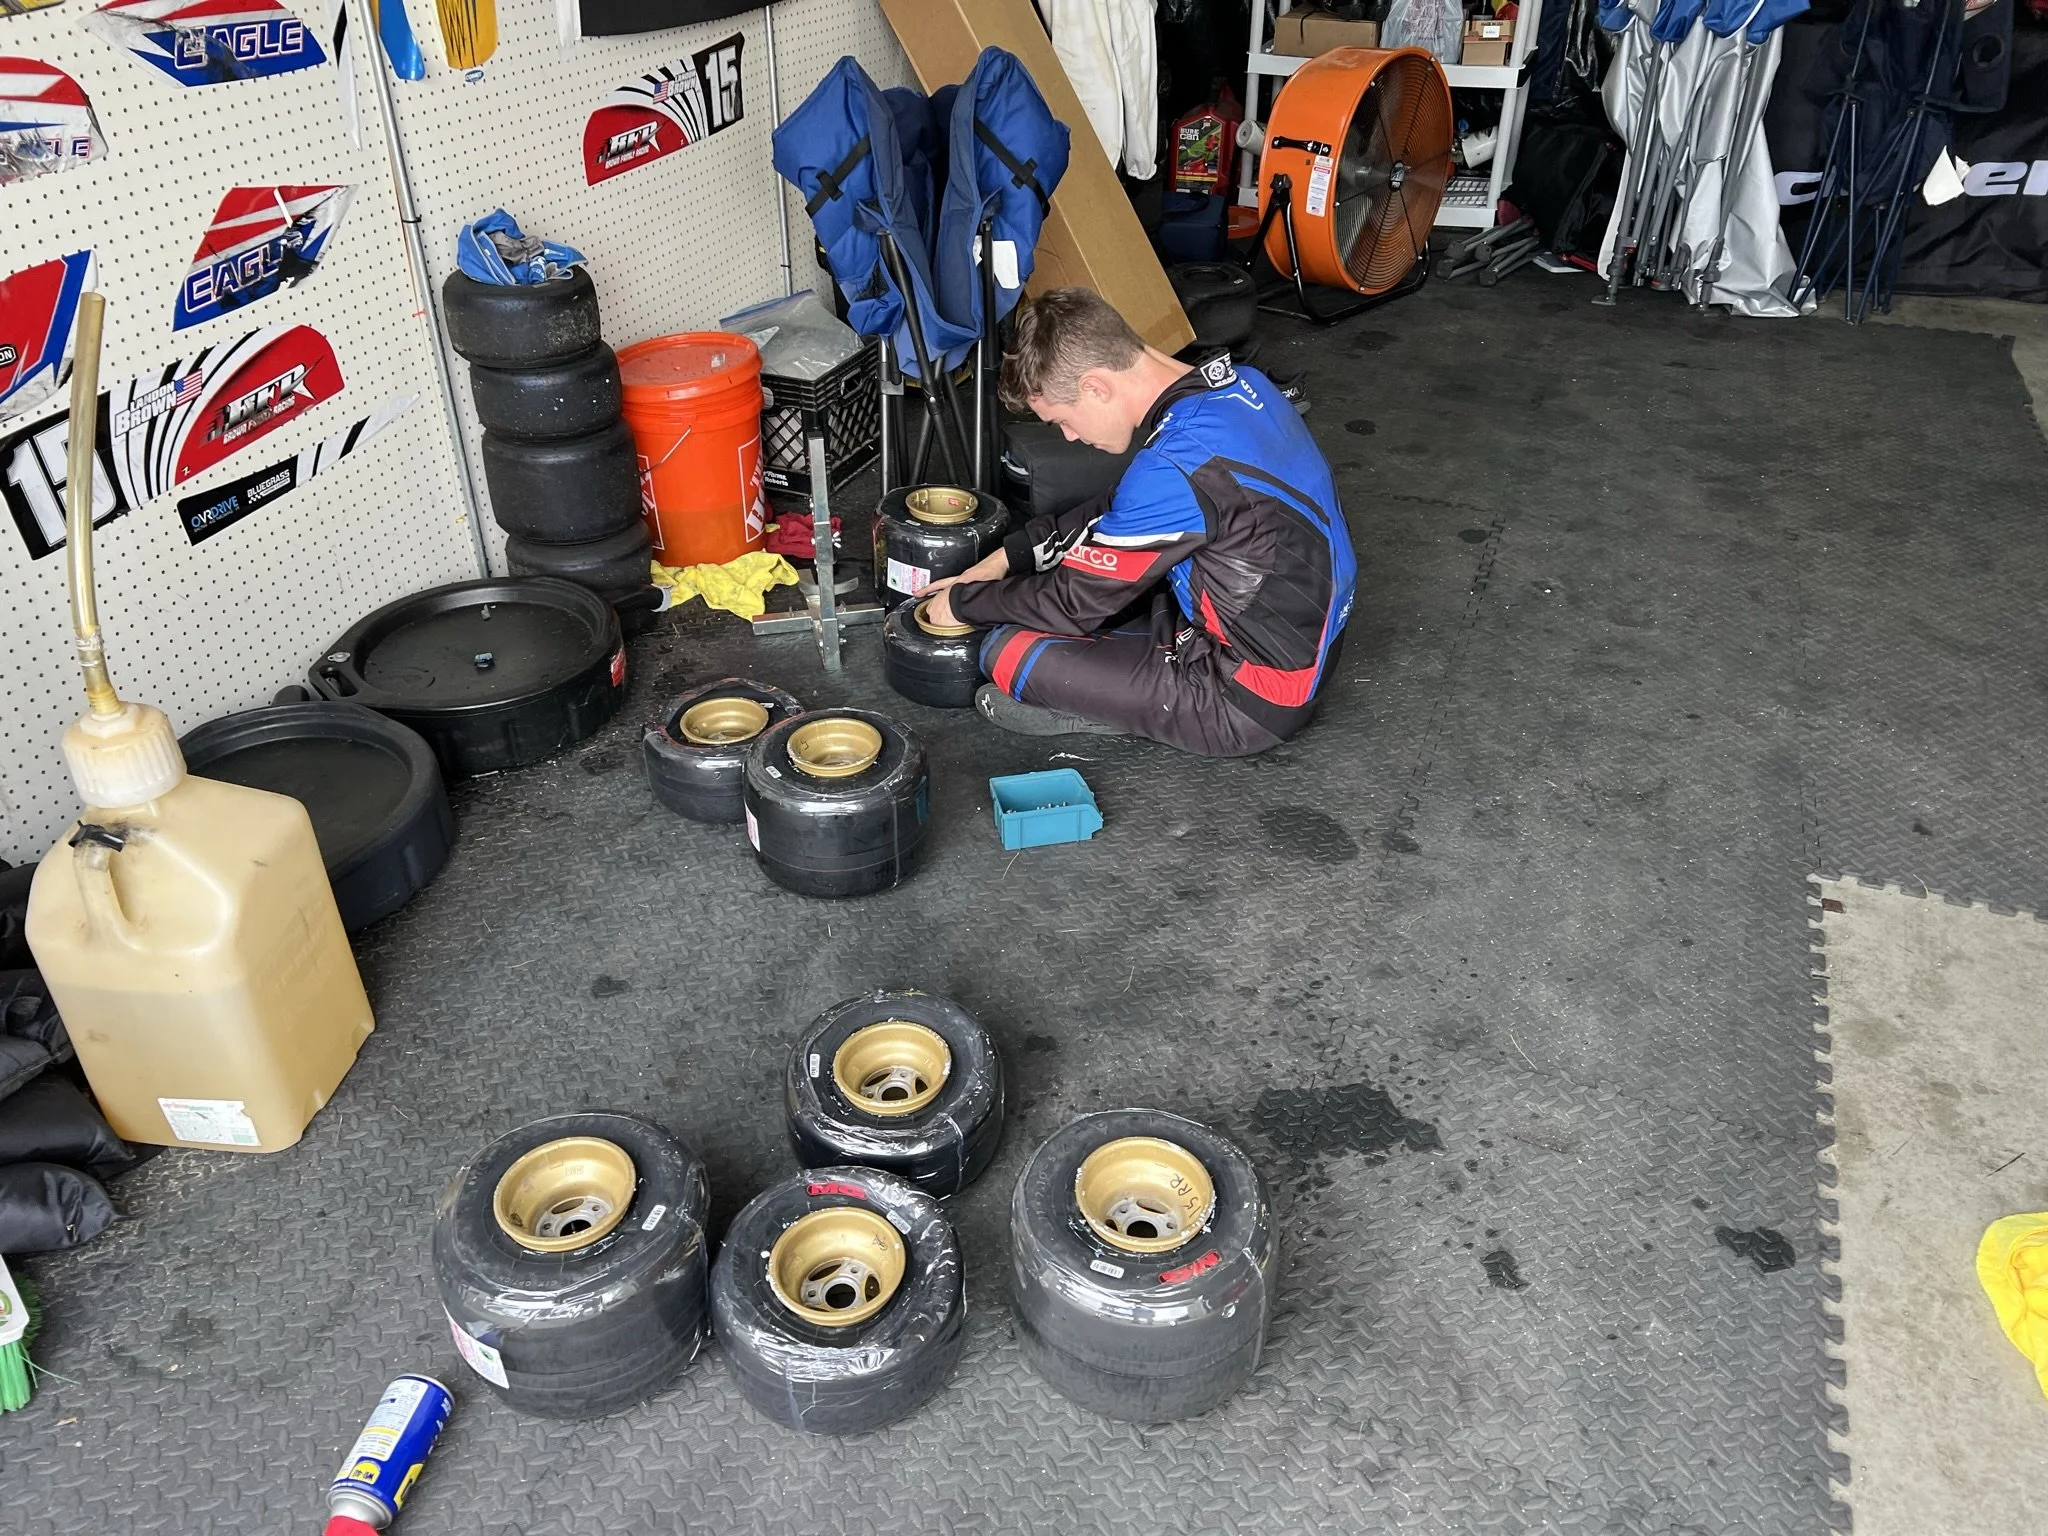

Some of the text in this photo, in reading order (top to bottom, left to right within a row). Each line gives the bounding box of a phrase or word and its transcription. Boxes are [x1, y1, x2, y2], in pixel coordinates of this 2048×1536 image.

[174, 18, 304, 70] EAGLE
[704, 44, 740, 128] 15
[184, 231, 303, 313] EAGL
[114, 391, 177, 438] BROWN
[129, 381, 175, 412] LANDON
[246, 469, 290, 499] BLUEGRASS
[191, 495, 240, 529] OVRDRIVE
[1069, 544, 1118, 567] arco
